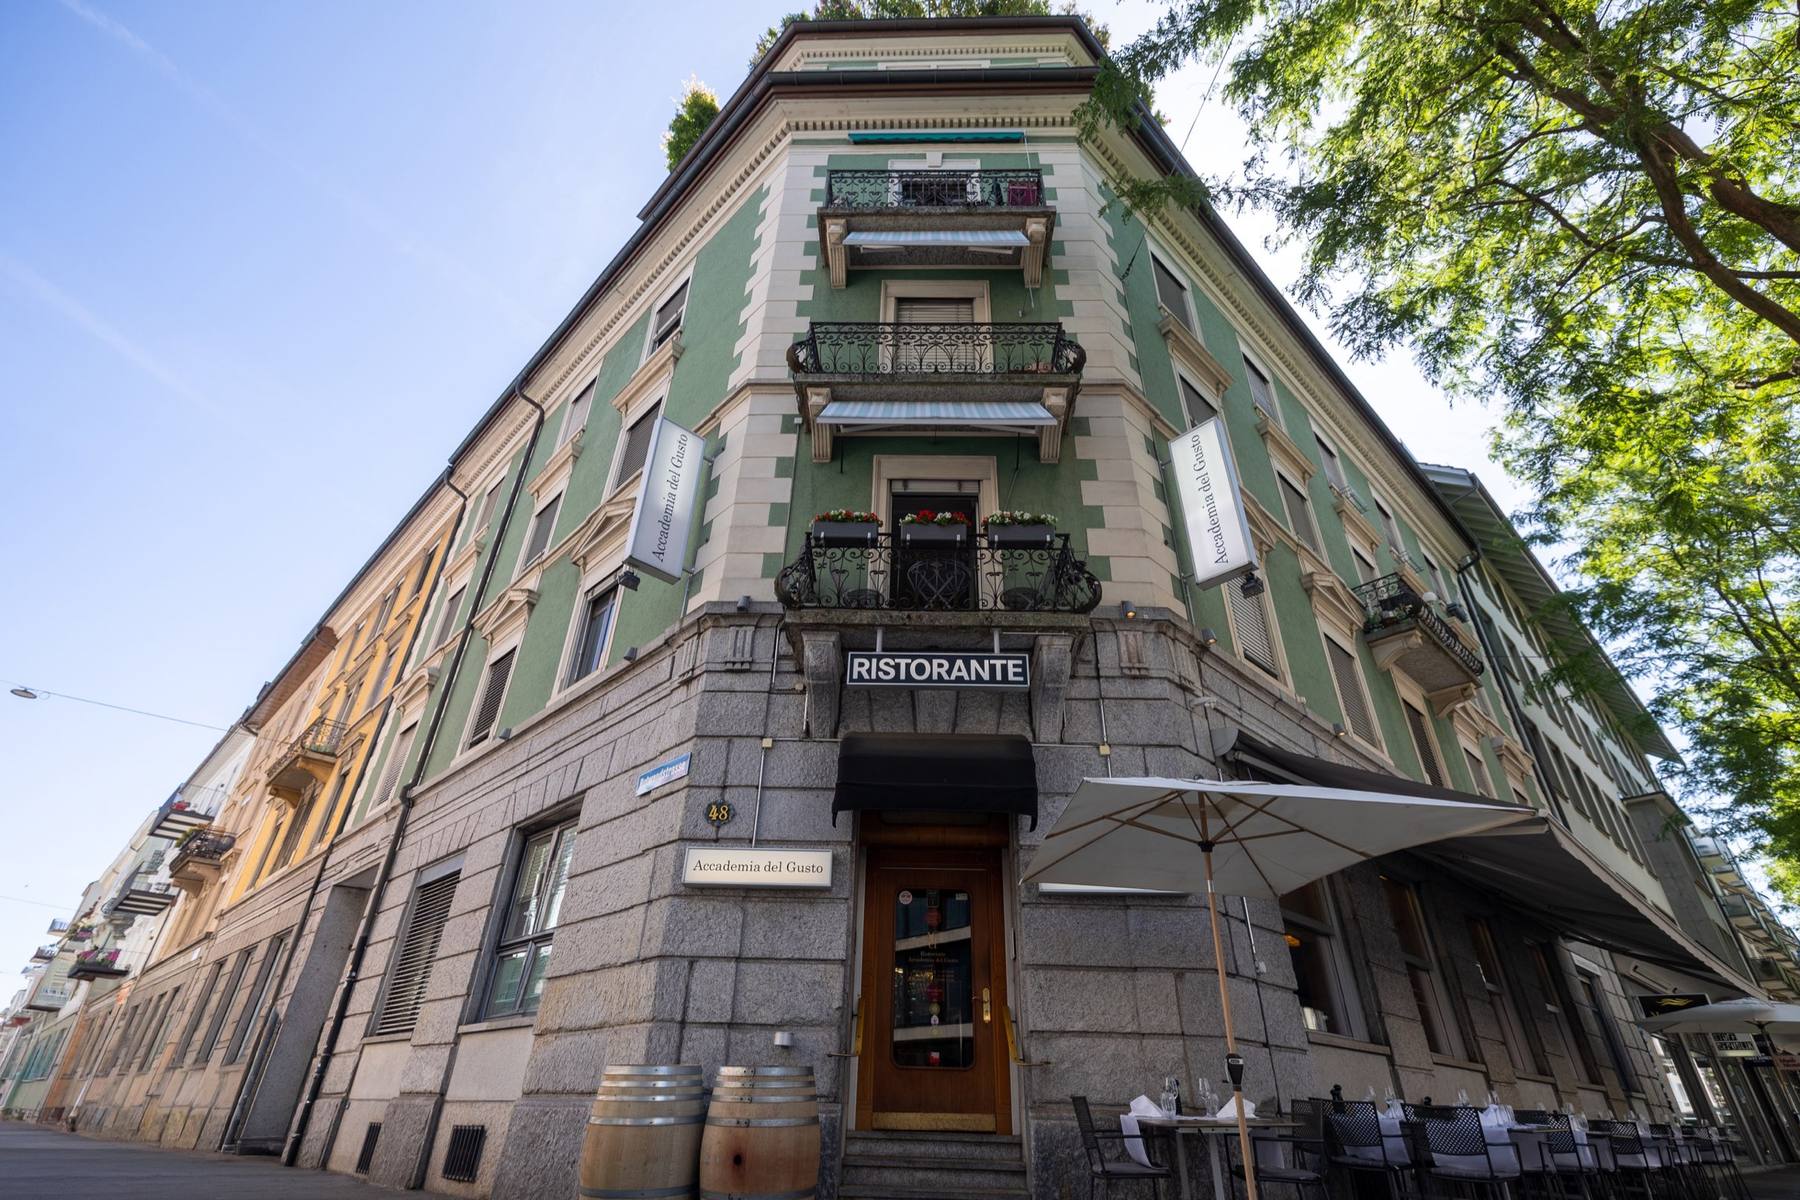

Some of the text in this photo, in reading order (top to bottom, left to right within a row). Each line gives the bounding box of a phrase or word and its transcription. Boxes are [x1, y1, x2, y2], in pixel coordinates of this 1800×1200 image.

[652, 433, 689, 563] Accademia del Gusto
[1191, 434, 1229, 564] Accademia del Gusto
[852, 657, 1024, 681] RISTORANTE
[708, 804, 729, 821] 48
[693, 860, 824, 874] Accademia del Gusto
